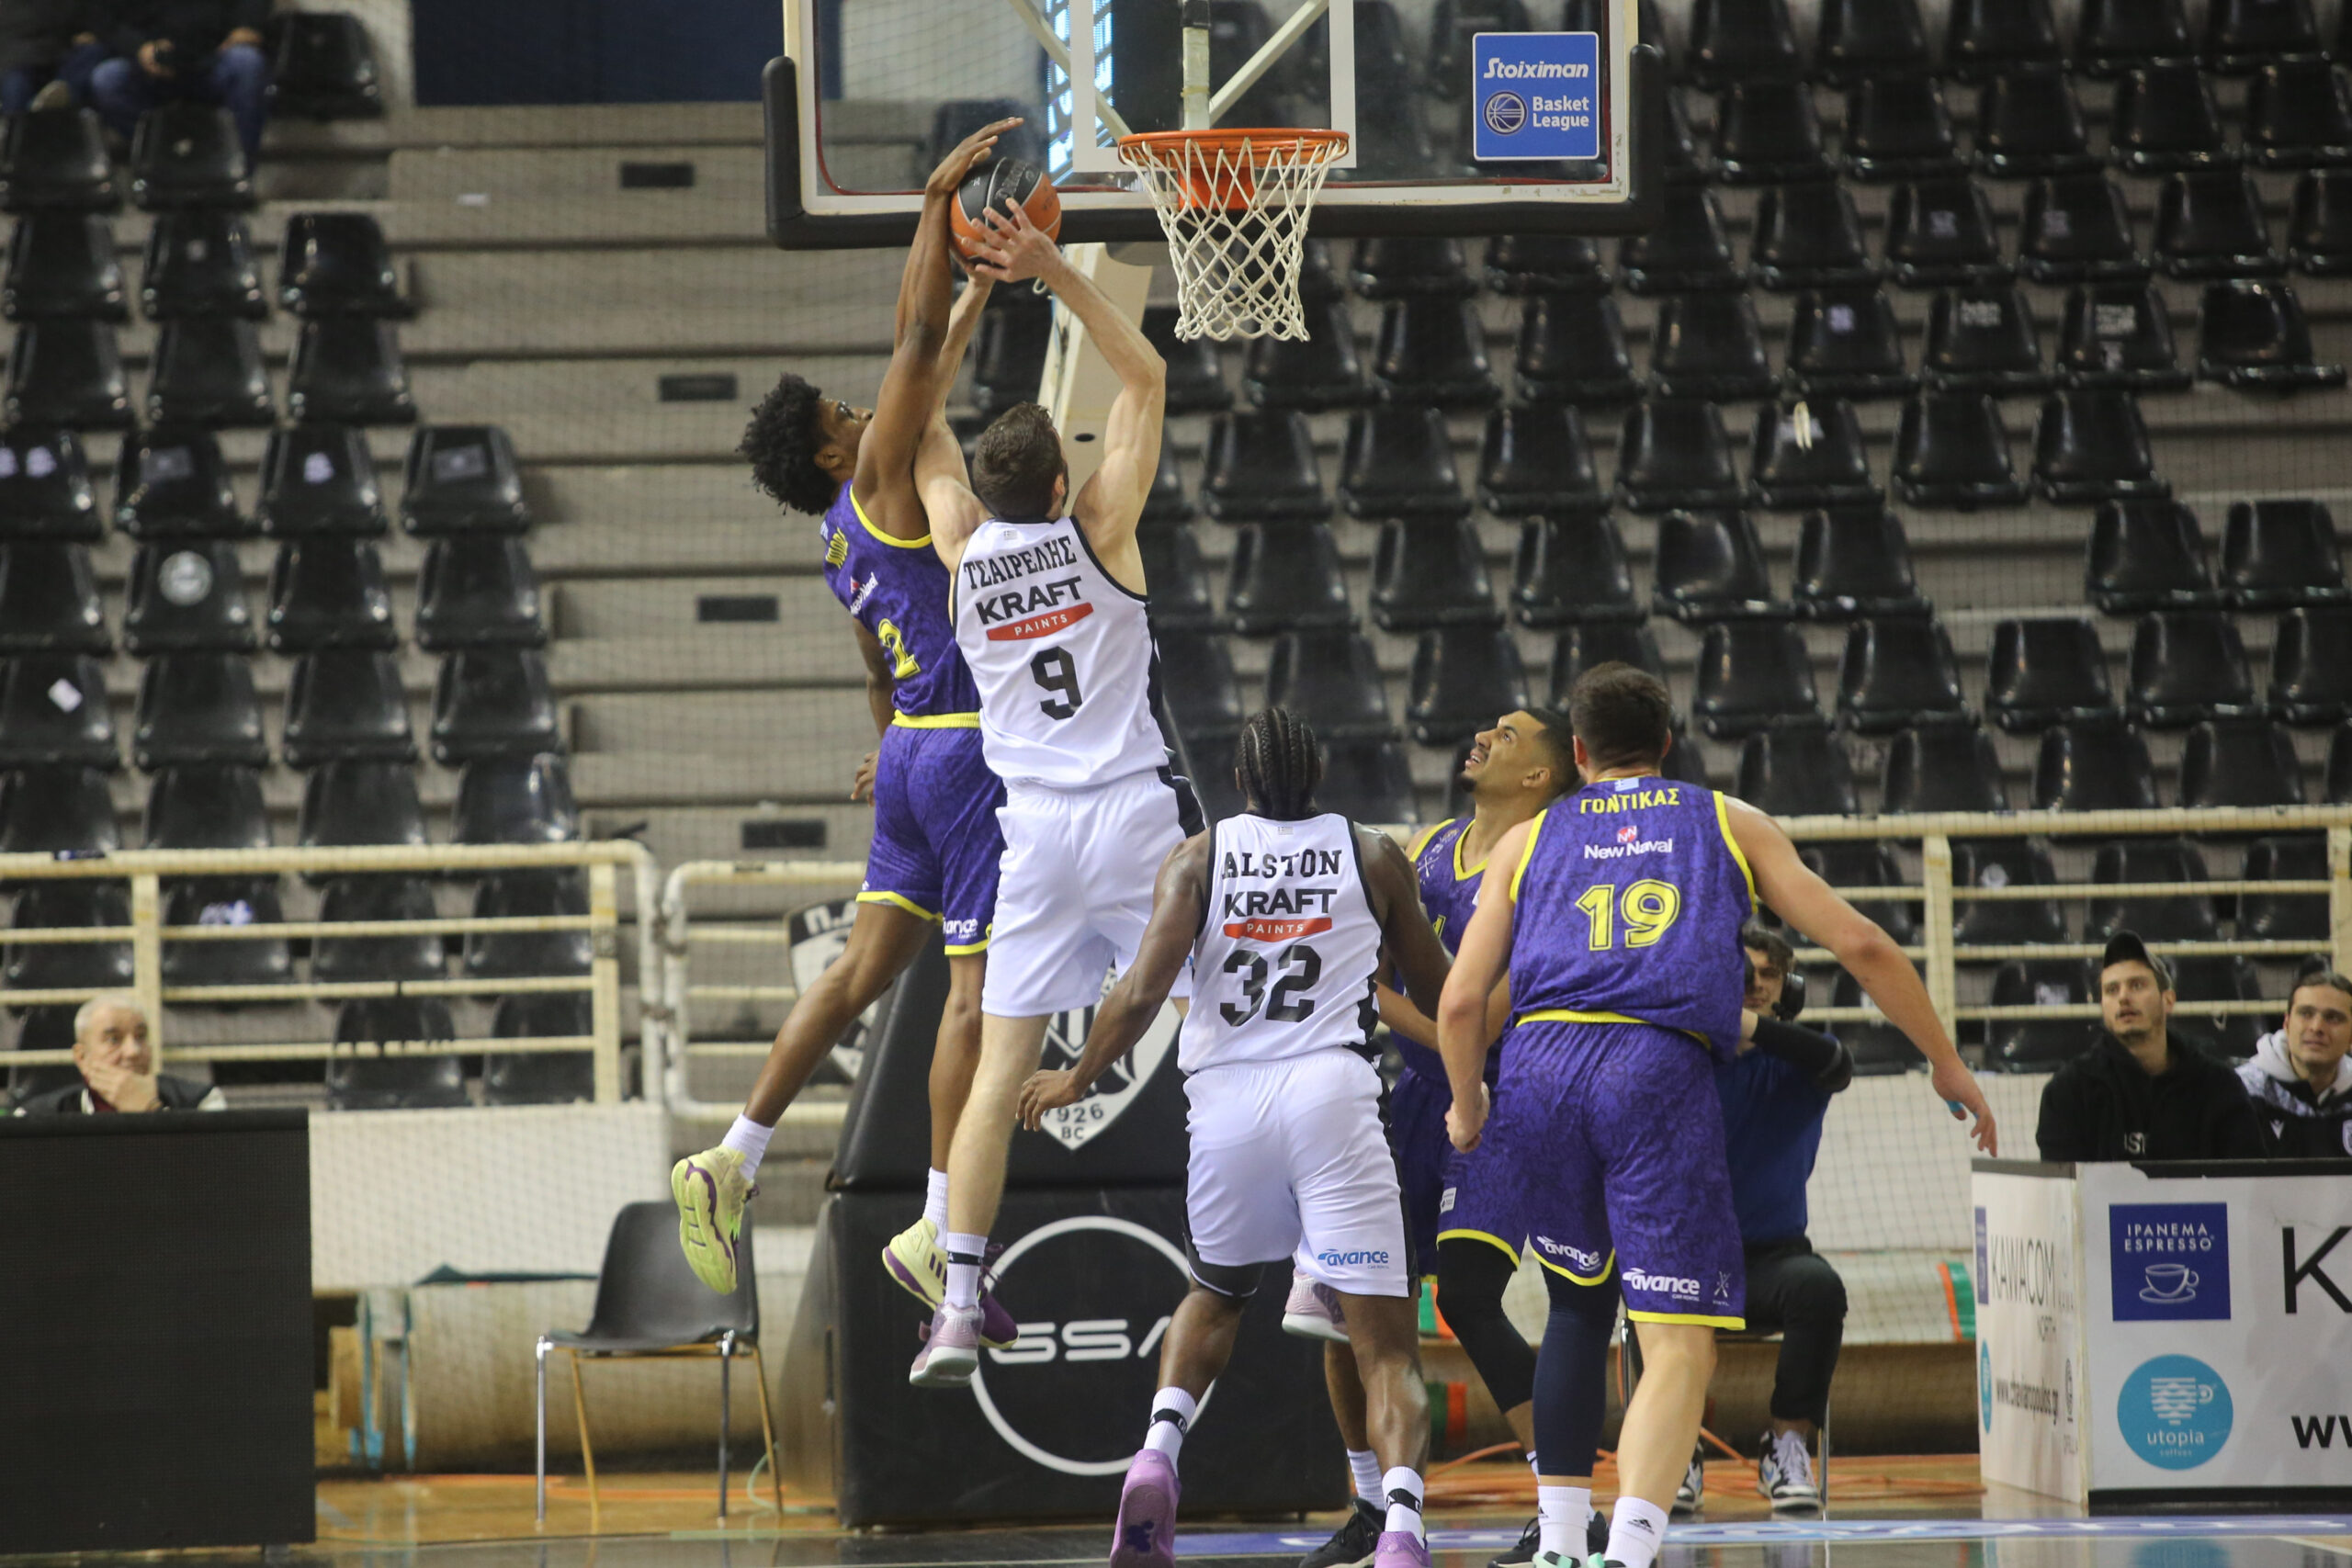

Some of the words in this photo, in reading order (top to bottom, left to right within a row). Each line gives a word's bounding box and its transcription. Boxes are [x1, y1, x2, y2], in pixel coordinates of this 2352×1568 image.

[1483, 57, 1589, 78] Stoiximan
[1532, 96, 1589, 111] Basket
[1532, 113, 1589, 131] League
[976, 575, 1082, 625] KRAFT
[1014, 614, 1068, 636] PAINTS
[878, 618, 921, 679] 2
[1031, 646, 1082, 720] 9
[1580, 788, 1679, 814] ΓΟΝΤΙΚΑΣ
[1584, 843, 1623, 859] New
[1626, 838, 1673, 856] Naval
[1222, 849, 1342, 879] ALSTON
[1225, 888, 1337, 919] KRAFT
[1575, 878, 1680, 951] 19
[944, 919, 978, 934] ance
[1247, 922, 1305, 934] PAINTS
[1220, 945, 1321, 1026] 32
[1061, 1126, 1085, 1140] BC
[2127, 1223, 2208, 1236] IPANEMA
[2124, 1237, 2211, 1252] ESPRESSO
[1322, 1250, 1389, 1266] avance
[1626, 1271, 1701, 1295] avance
[2147, 1428, 2204, 1447] utopia
